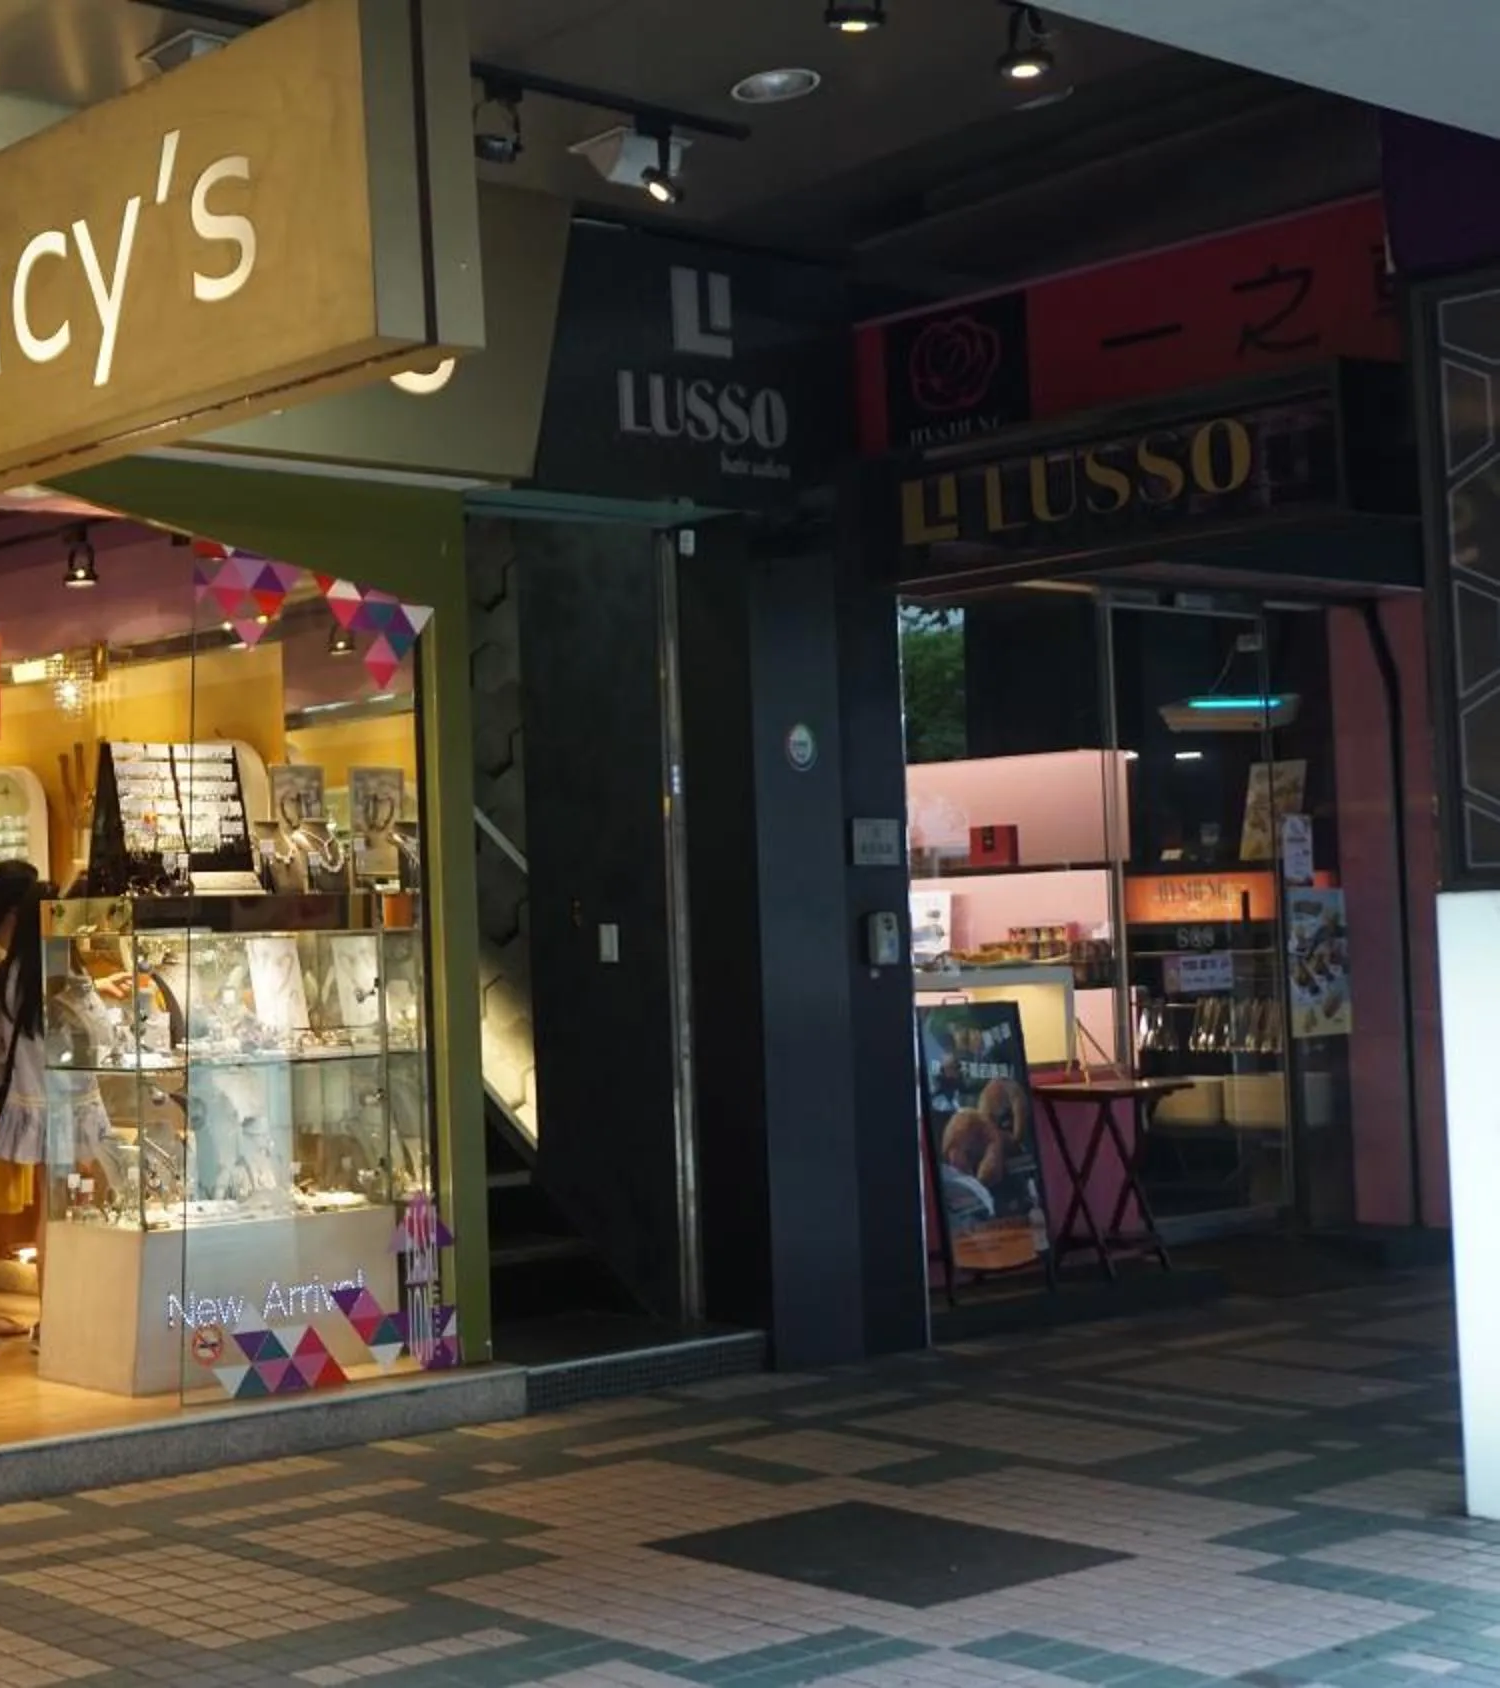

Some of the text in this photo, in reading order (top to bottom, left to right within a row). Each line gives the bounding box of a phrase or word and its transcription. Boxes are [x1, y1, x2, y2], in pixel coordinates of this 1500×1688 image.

[617, 369, 787, 449] LUSSO
[984, 417, 1251, 533] LUSSO
[168, 1293, 244, 1328] New
